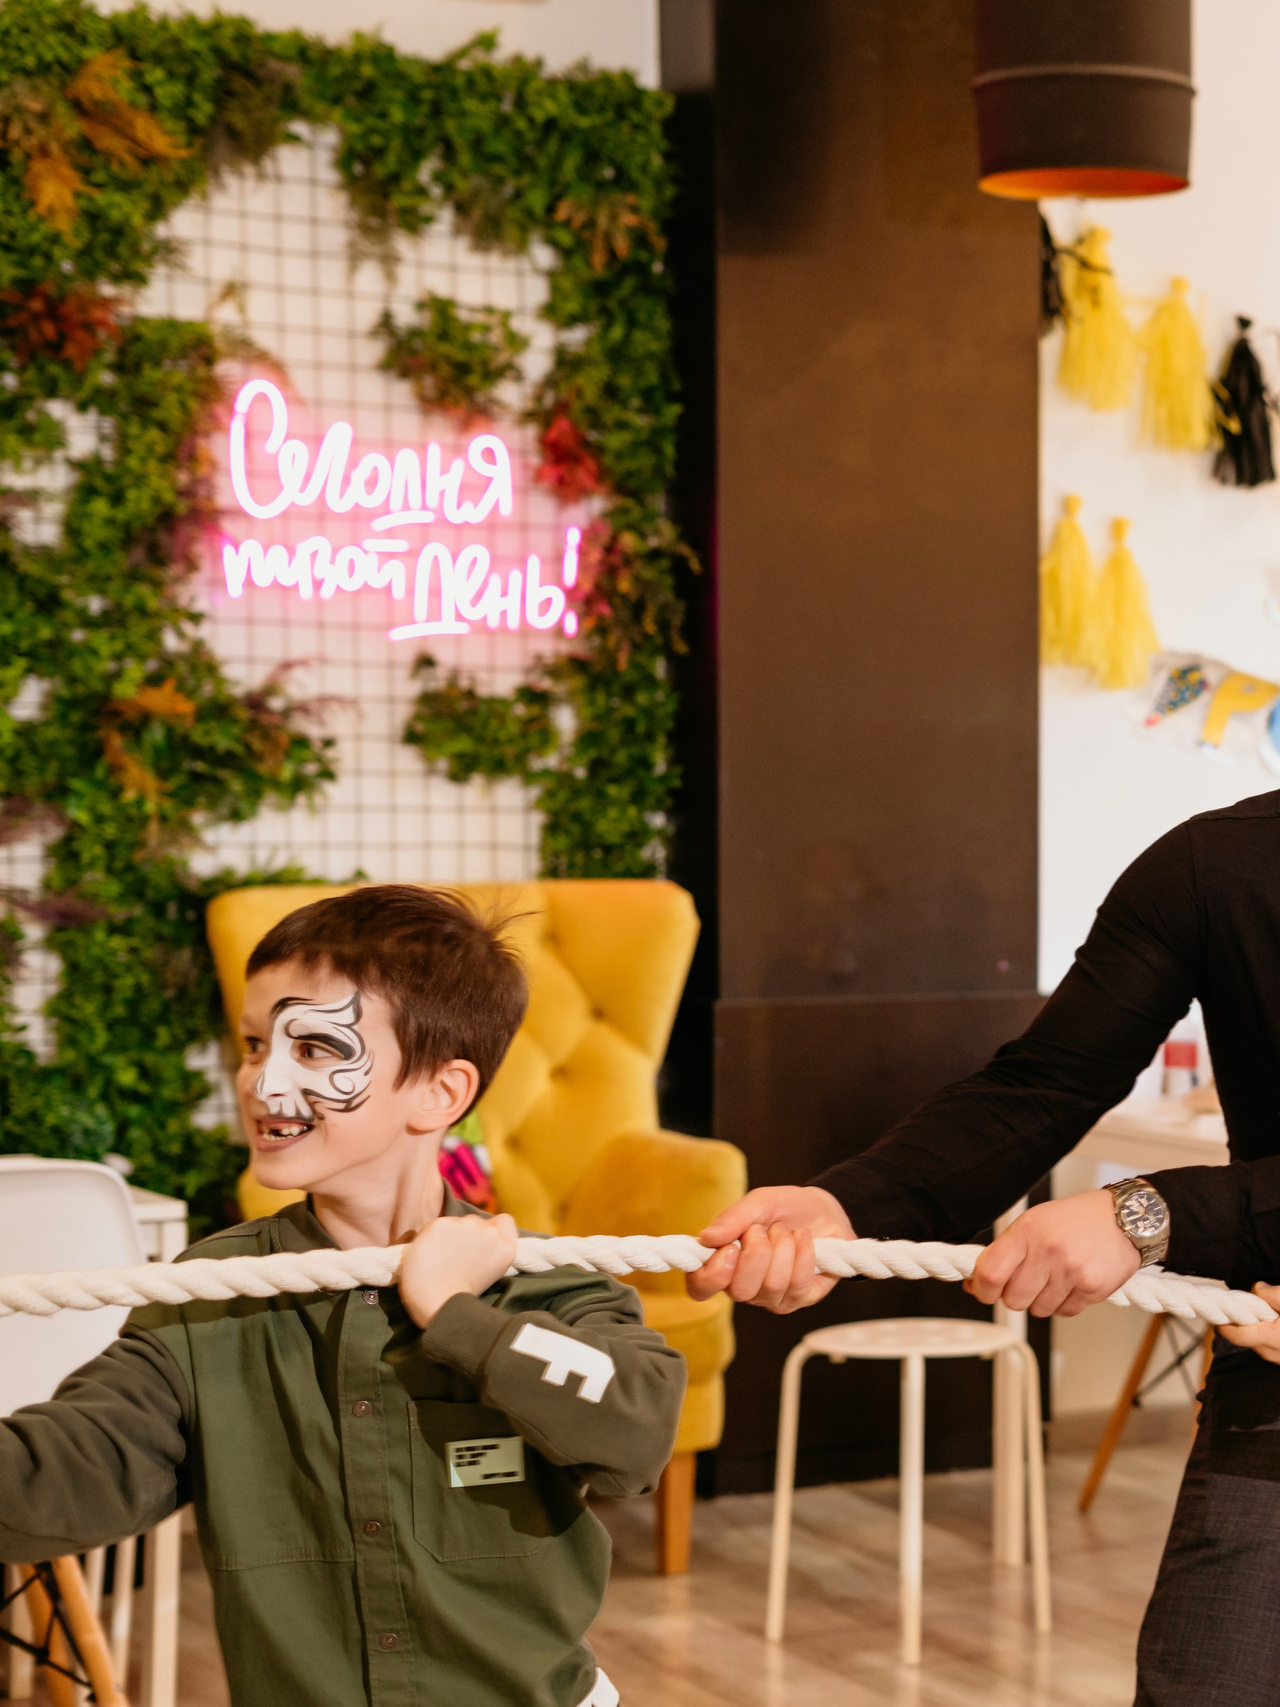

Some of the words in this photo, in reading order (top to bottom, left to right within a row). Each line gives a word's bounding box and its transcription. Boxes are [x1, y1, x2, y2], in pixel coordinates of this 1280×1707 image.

[229, 379, 515, 531] Сегодня
[222, 536, 409, 600] твой
[509, 1322, 616, 1404] F
